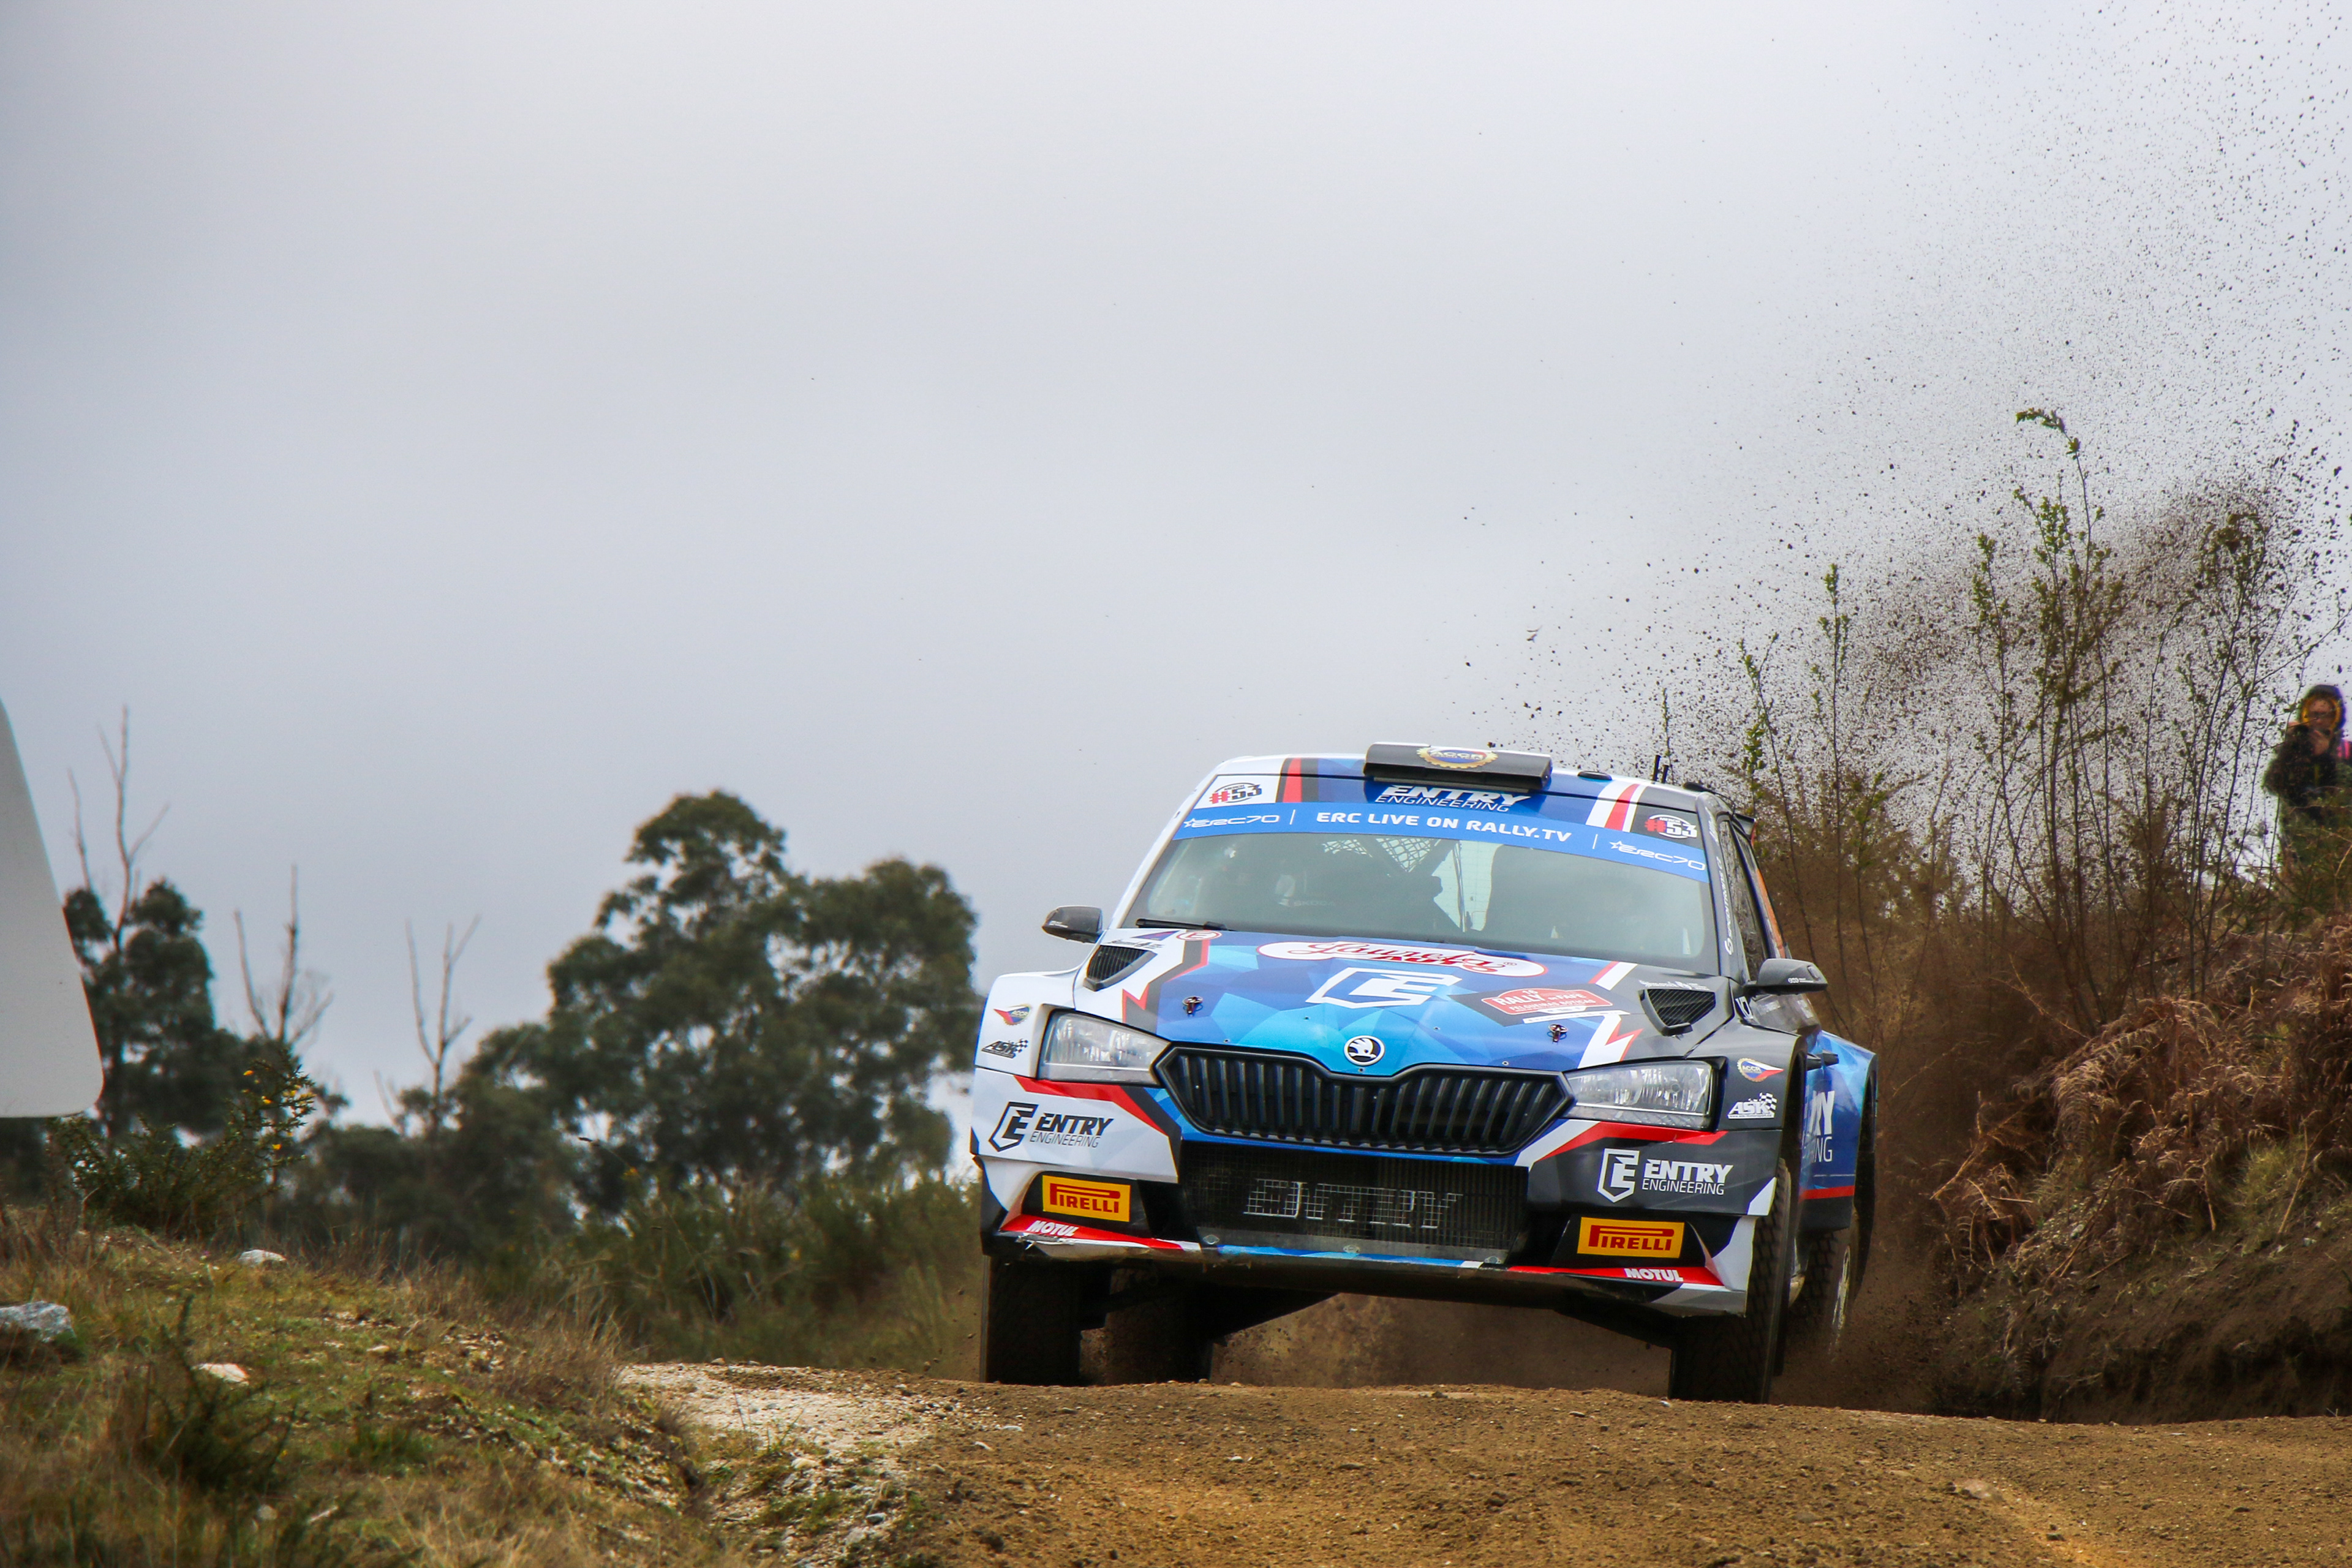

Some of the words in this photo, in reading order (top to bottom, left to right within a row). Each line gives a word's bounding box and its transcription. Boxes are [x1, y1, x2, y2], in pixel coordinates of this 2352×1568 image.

[1209, 784, 1262, 804] #53
[1374, 795, 1509, 812] ENGINEERING
[1382, 785, 1531, 805] ENTRY
[1316, 812, 1362, 823] ERC
[1367, 813, 1419, 826] LIVE
[1426, 816, 1459, 829] ON
[1466, 820, 1572, 842] RALLY.TV
[1645, 818, 1698, 838] #53
[1491, 993, 1546, 1006] RALLY
[1509, 1001, 1560, 1011] FELGUEIRAS
[1728, 1101, 1771, 1114] ASK
[1035, 1112, 1115, 1136] ENTRY
[1030, 1131, 1101, 1148] ENGINEERING
[1643, 1158, 1734, 1184] ENTRY
[1642, 1178, 1725, 1196] ENGINEERING
[1049, 1182, 1121, 1213] PIRELLI
[1026, 1219, 1079, 1237] MOTUL
[1588, 1224, 1675, 1251] PIRELLI
[1623, 1267, 1684, 1282] MOTUL
